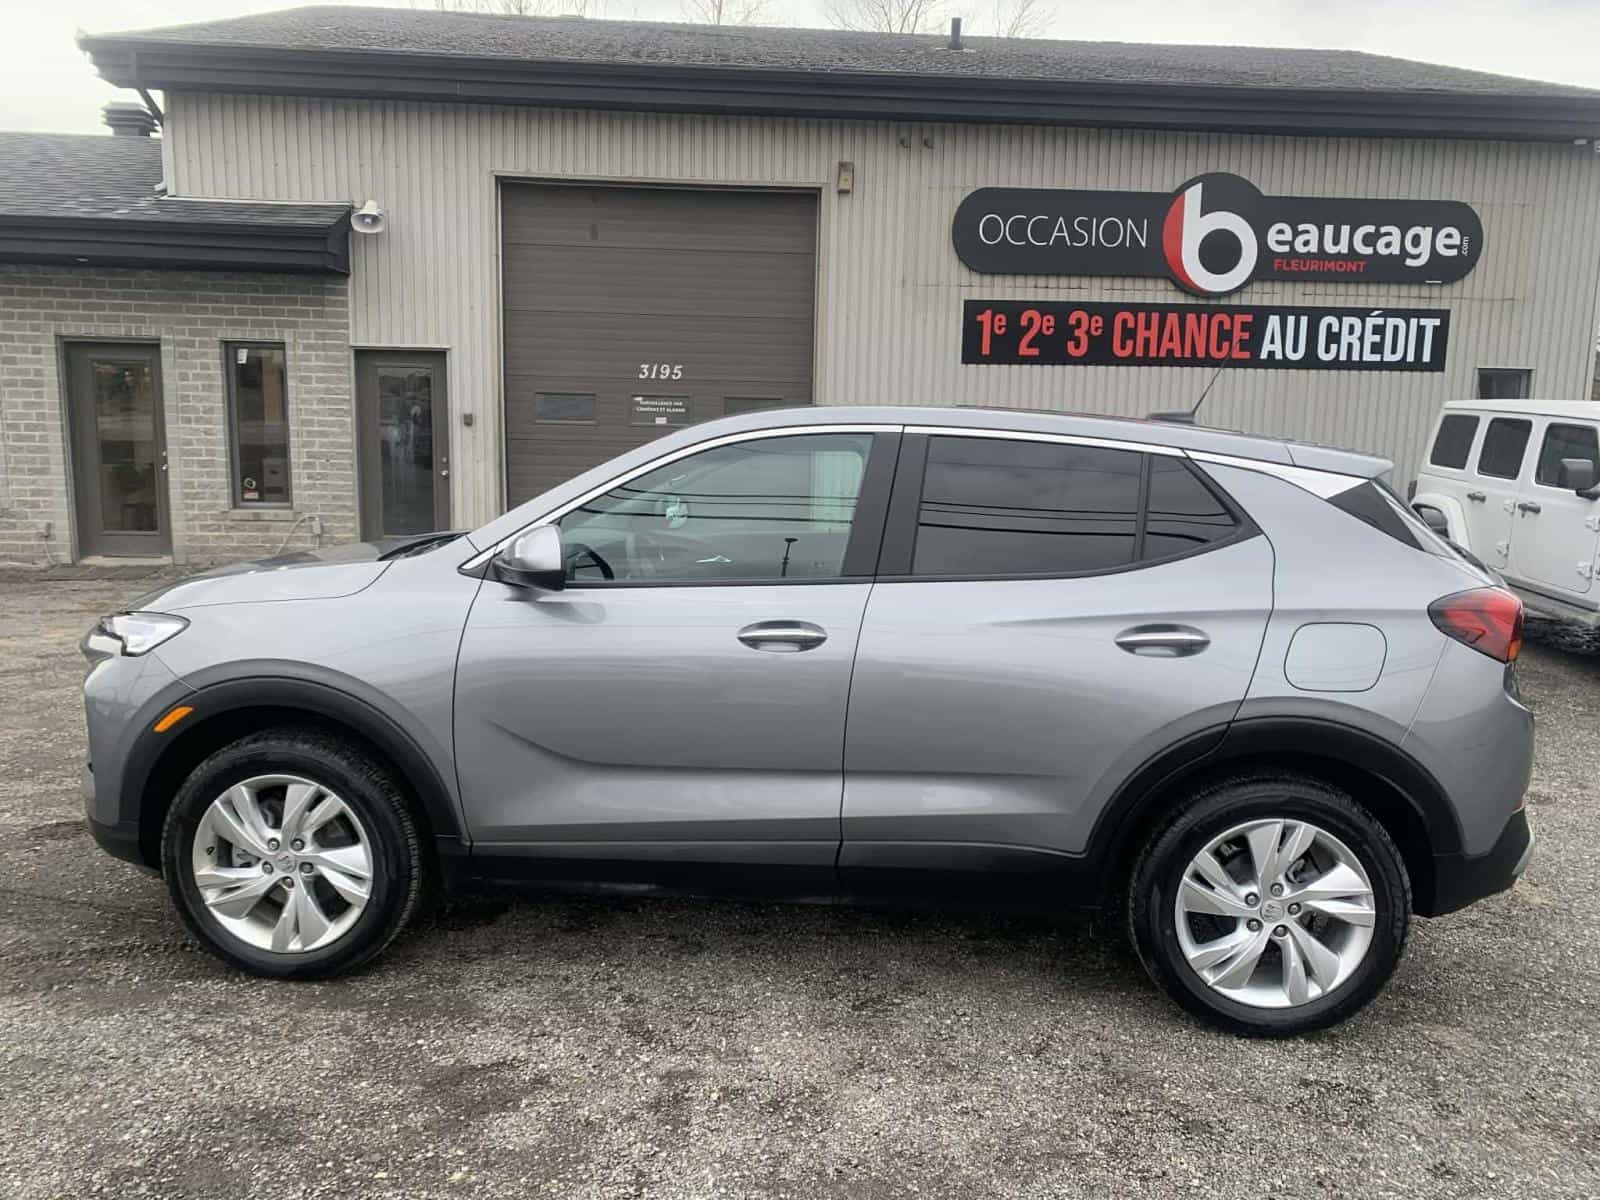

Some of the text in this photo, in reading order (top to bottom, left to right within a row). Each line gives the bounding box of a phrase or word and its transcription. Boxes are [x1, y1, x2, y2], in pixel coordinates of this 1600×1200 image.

[978, 213, 1149, 249] OCCASION
[1272, 258, 1367, 273] FLEURIMONT
[975, 309, 1441, 363] 1e 2e 3e CHANCE AU CRÉDIT
[638, 363, 684, 380] 3195
